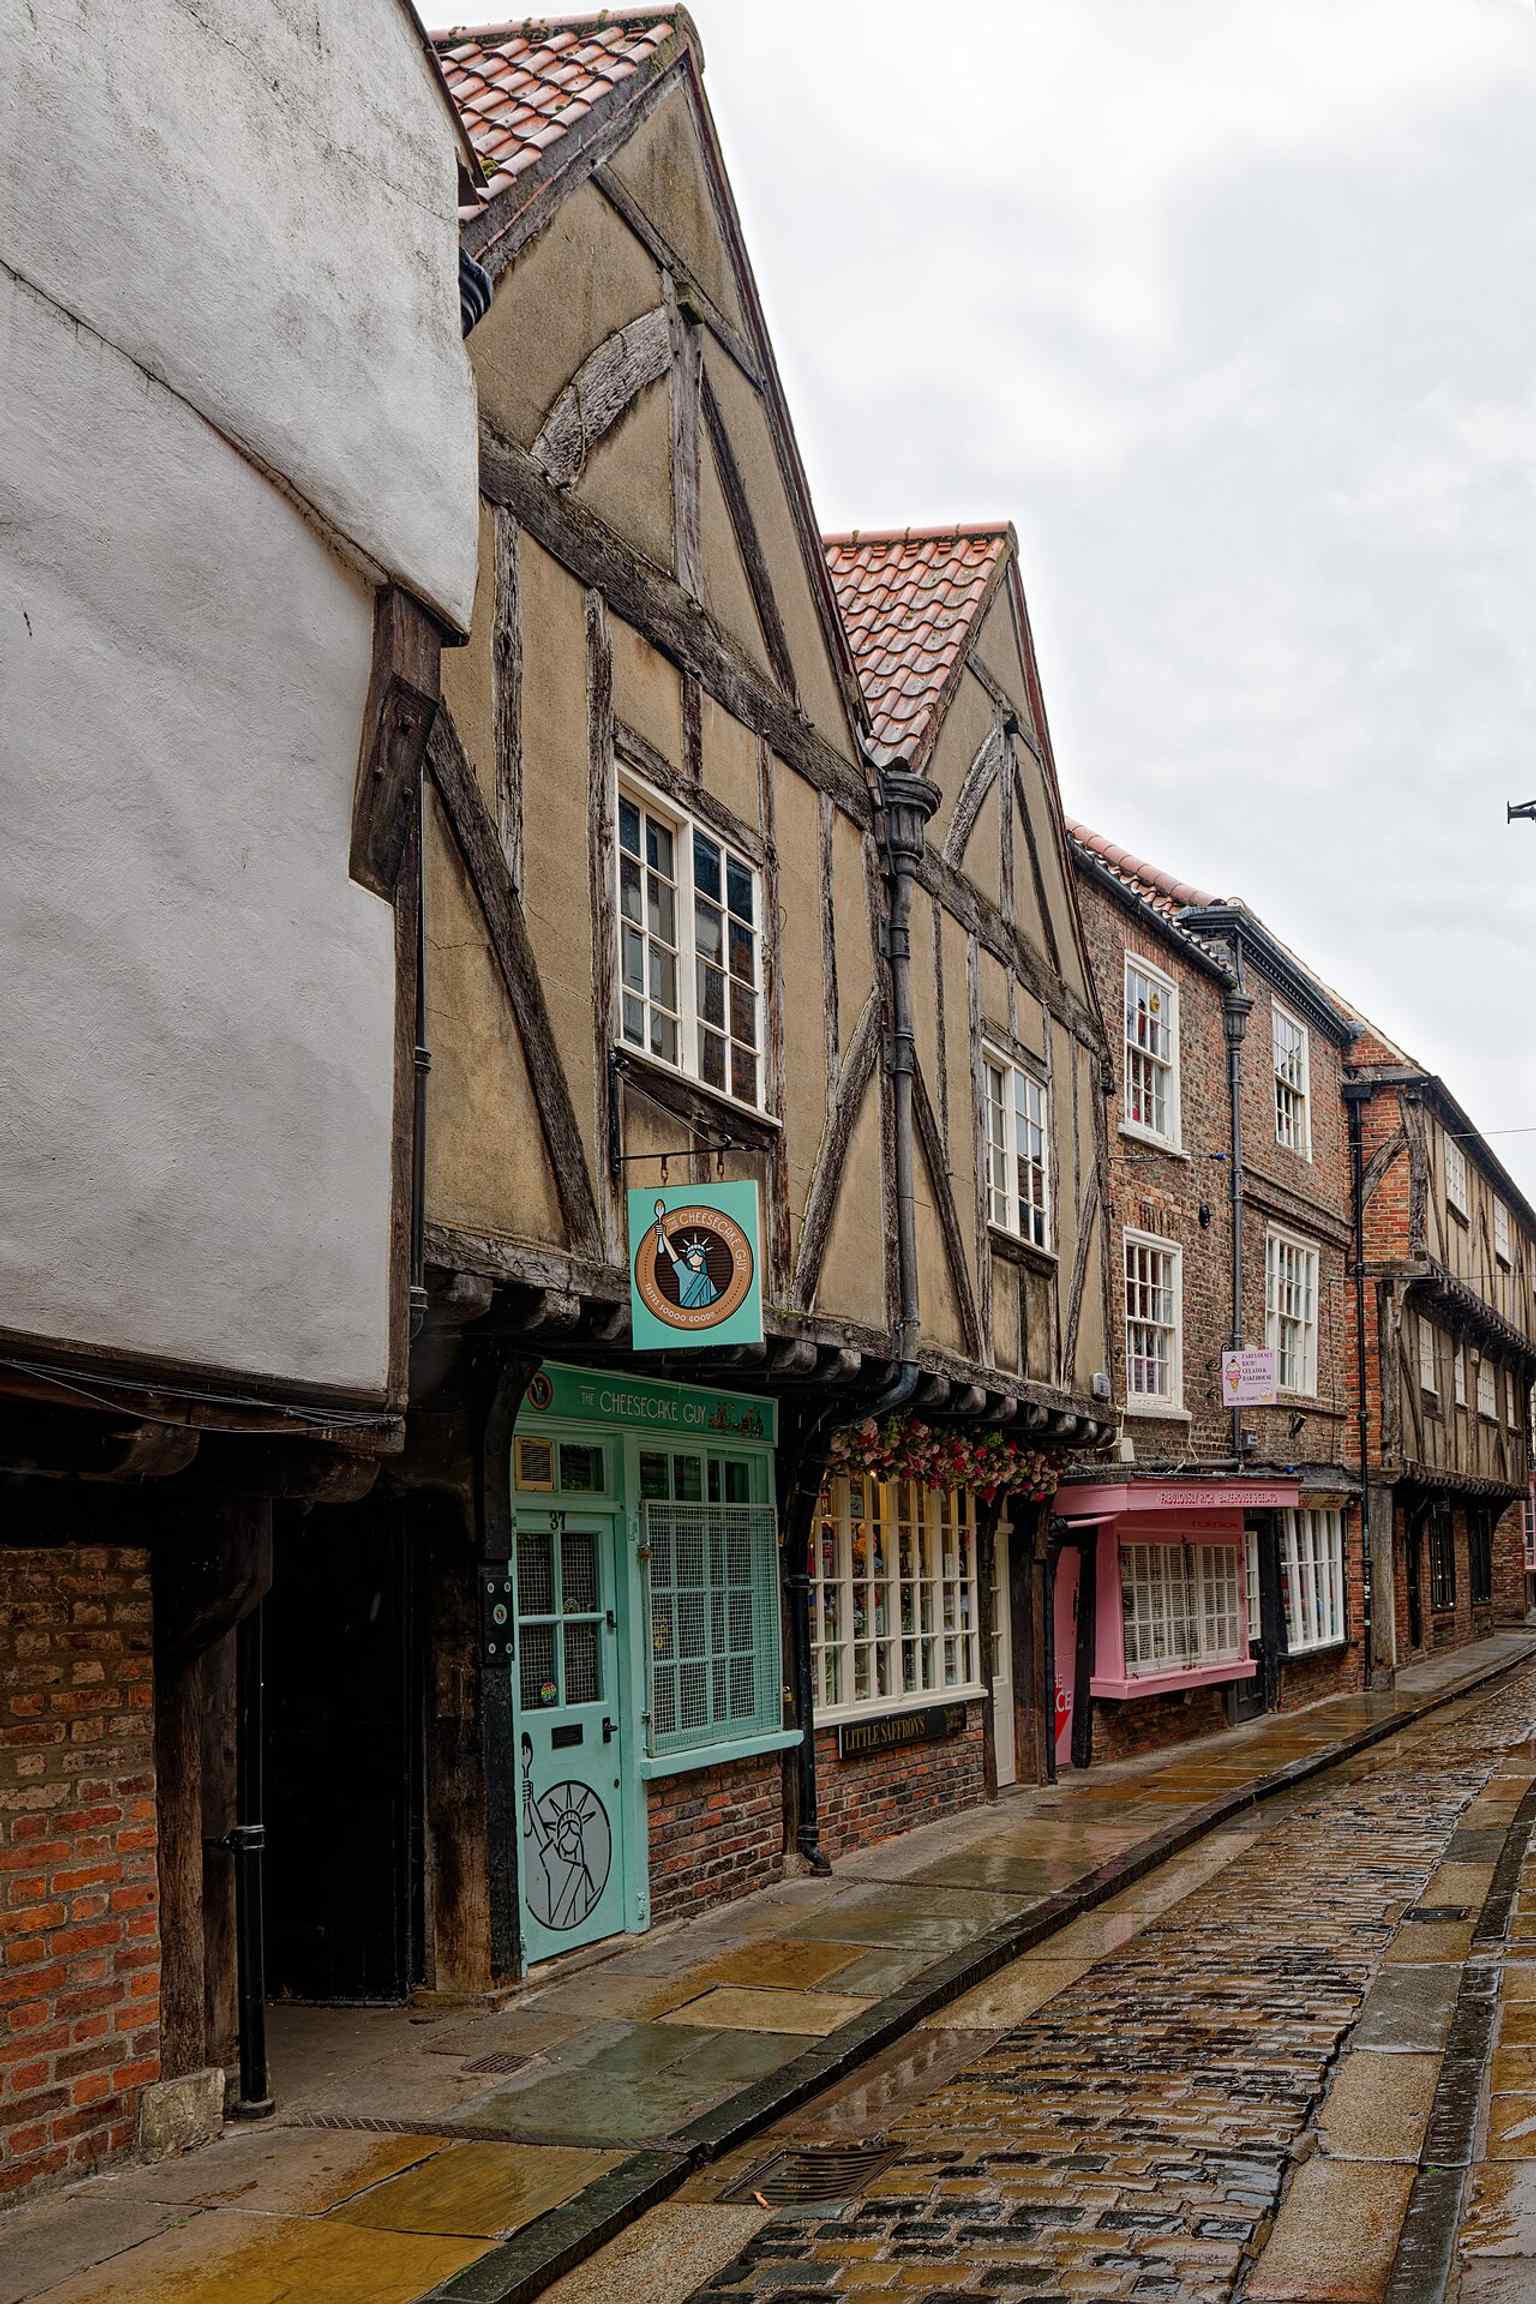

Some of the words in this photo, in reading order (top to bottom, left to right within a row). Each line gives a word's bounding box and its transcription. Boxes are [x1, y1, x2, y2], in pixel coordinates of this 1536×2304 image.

[679, 1212, 741, 1247] CHEESECAKE
[735, 1248, 748, 1273] GUY
[581, 1391, 595, 1407] THE
[599, 1391, 679, 1422] CHEESECAKE
[683, 1402, 707, 1426] GUY
[550, 1510, 566, 1531] 37
[845, 1724, 880, 1752] LITTLE
